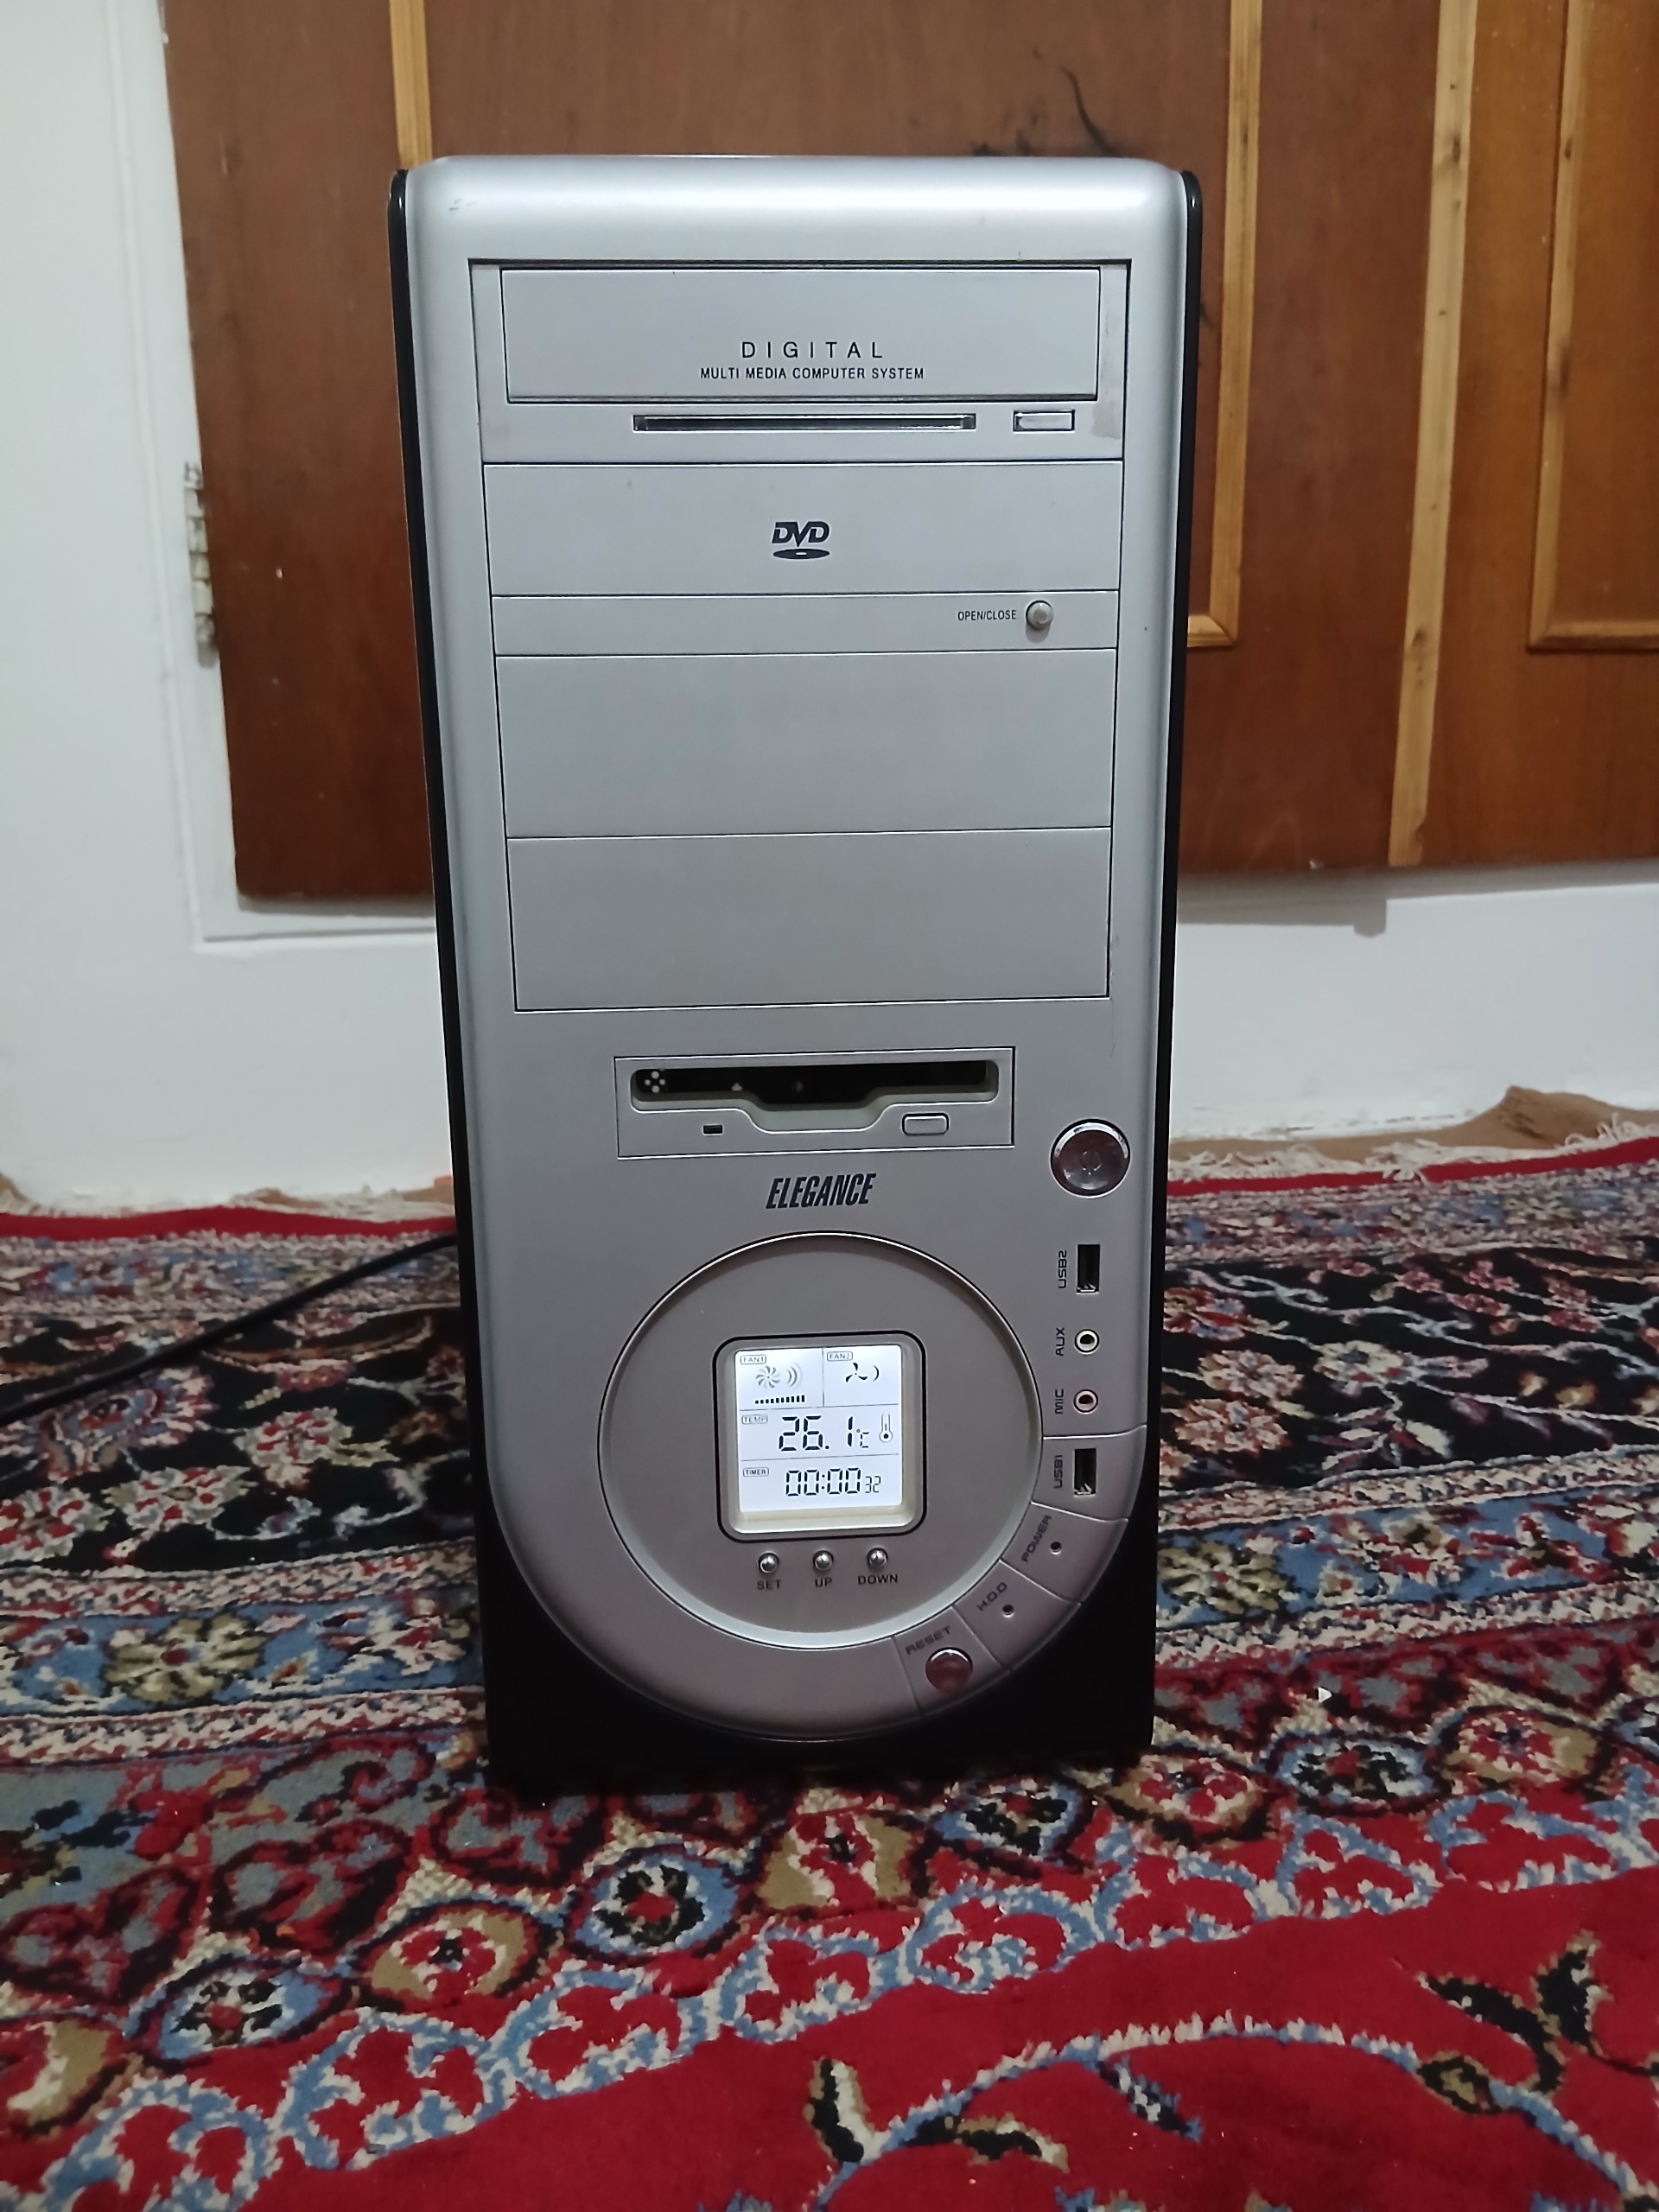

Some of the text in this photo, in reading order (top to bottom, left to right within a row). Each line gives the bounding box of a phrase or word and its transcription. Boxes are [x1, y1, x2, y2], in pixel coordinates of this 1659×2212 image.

[741, 341, 883, 359] DIGITAL
[700, 367, 925, 380] MULTI MEDIA COMPUTER SYSTEM
[772, 520, 830, 547] DVD
[957, 609, 1017, 621] OPEN/CLOSE
[766, 1173, 876, 1209] ELEGANCE
[1057, 1249, 1068, 1289] USB2
[1055, 1326, 1065, 1357] AUX
[742, 1355, 765, 1363] FAN1
[829, 1352, 851, 1361] FAN2
[1054, 1389, 1065, 1414] MIC
[1052, 1453, 1064, 1489] USB1
[1020, 1514, 1052, 1562] POWER
[757, 1579, 782, 1590] SET
[814, 1577, 833, 1588] UP
[857, 1573, 899, 1586] DOWN
[905, 1624, 951, 1656] RESET
